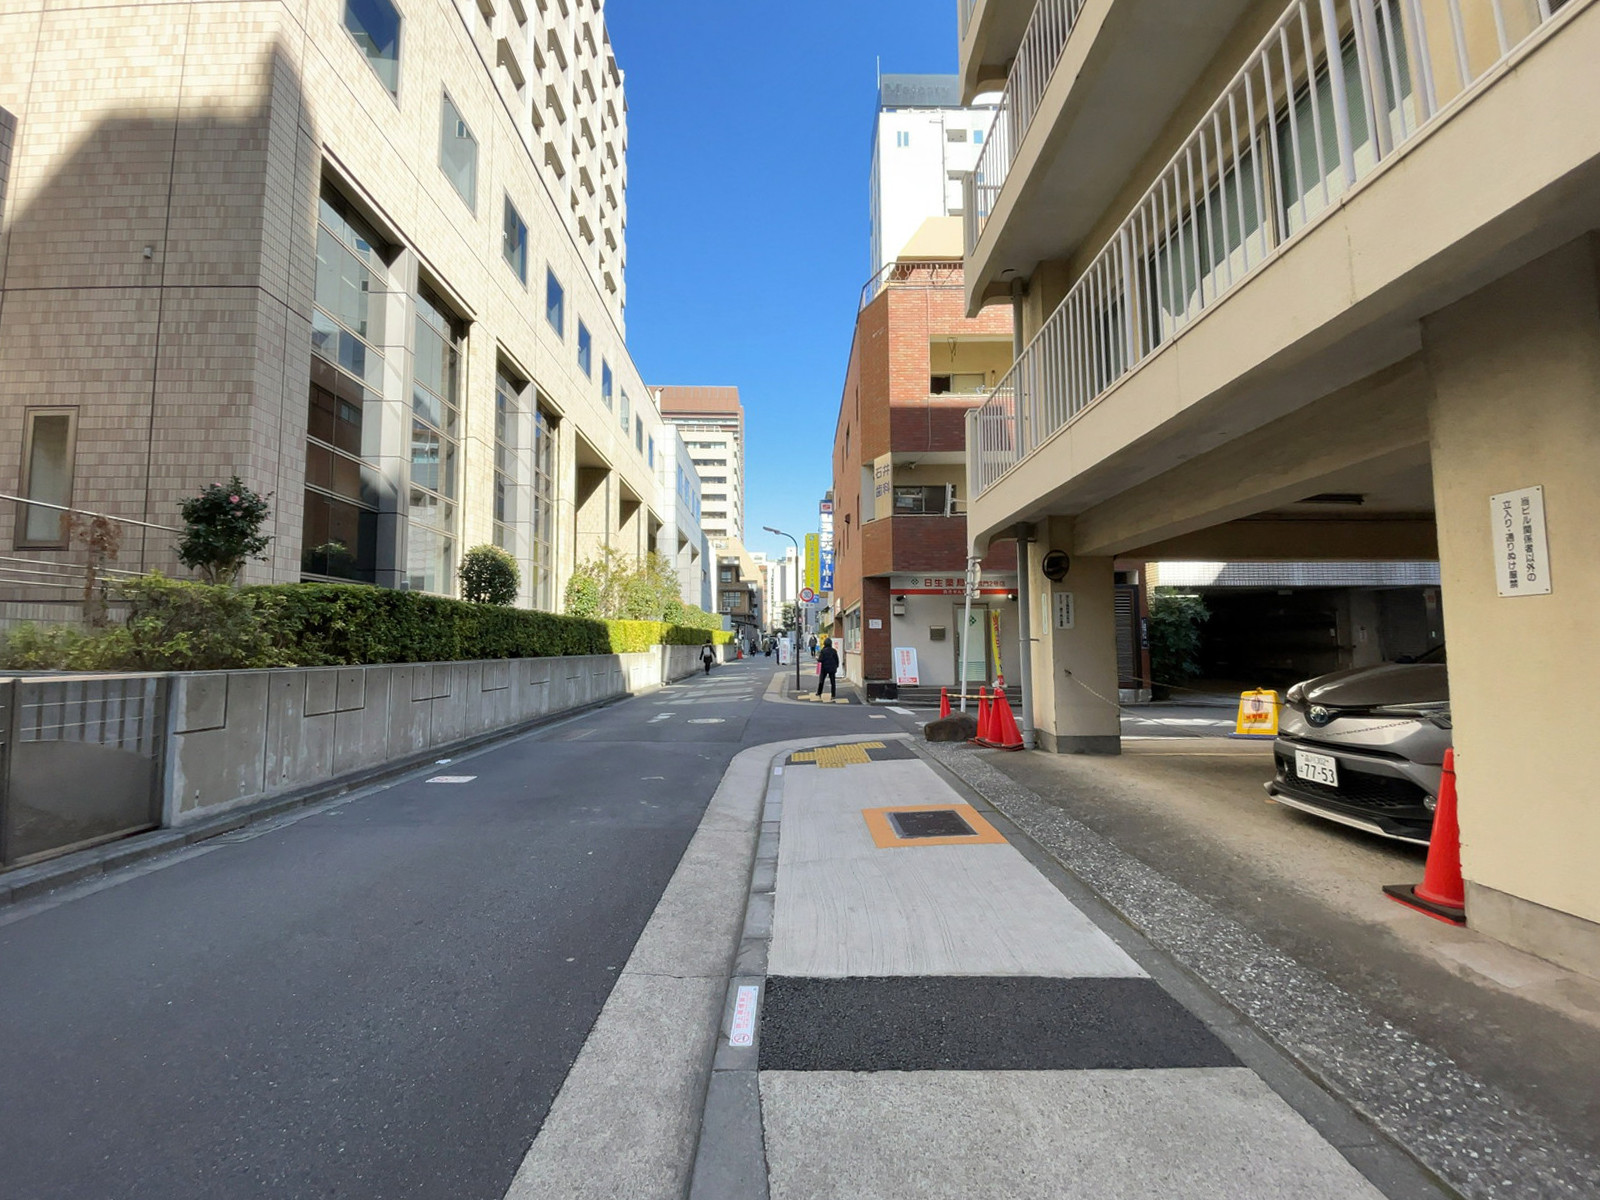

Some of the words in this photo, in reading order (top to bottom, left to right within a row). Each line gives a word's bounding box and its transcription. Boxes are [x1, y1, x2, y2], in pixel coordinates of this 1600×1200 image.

[875, 463, 890, 479] 石井
[876, 481, 890, 498] 歯科
[924, 578, 966, 588] 日生薬局
[1304, 763, 1335, 784] 77-53
